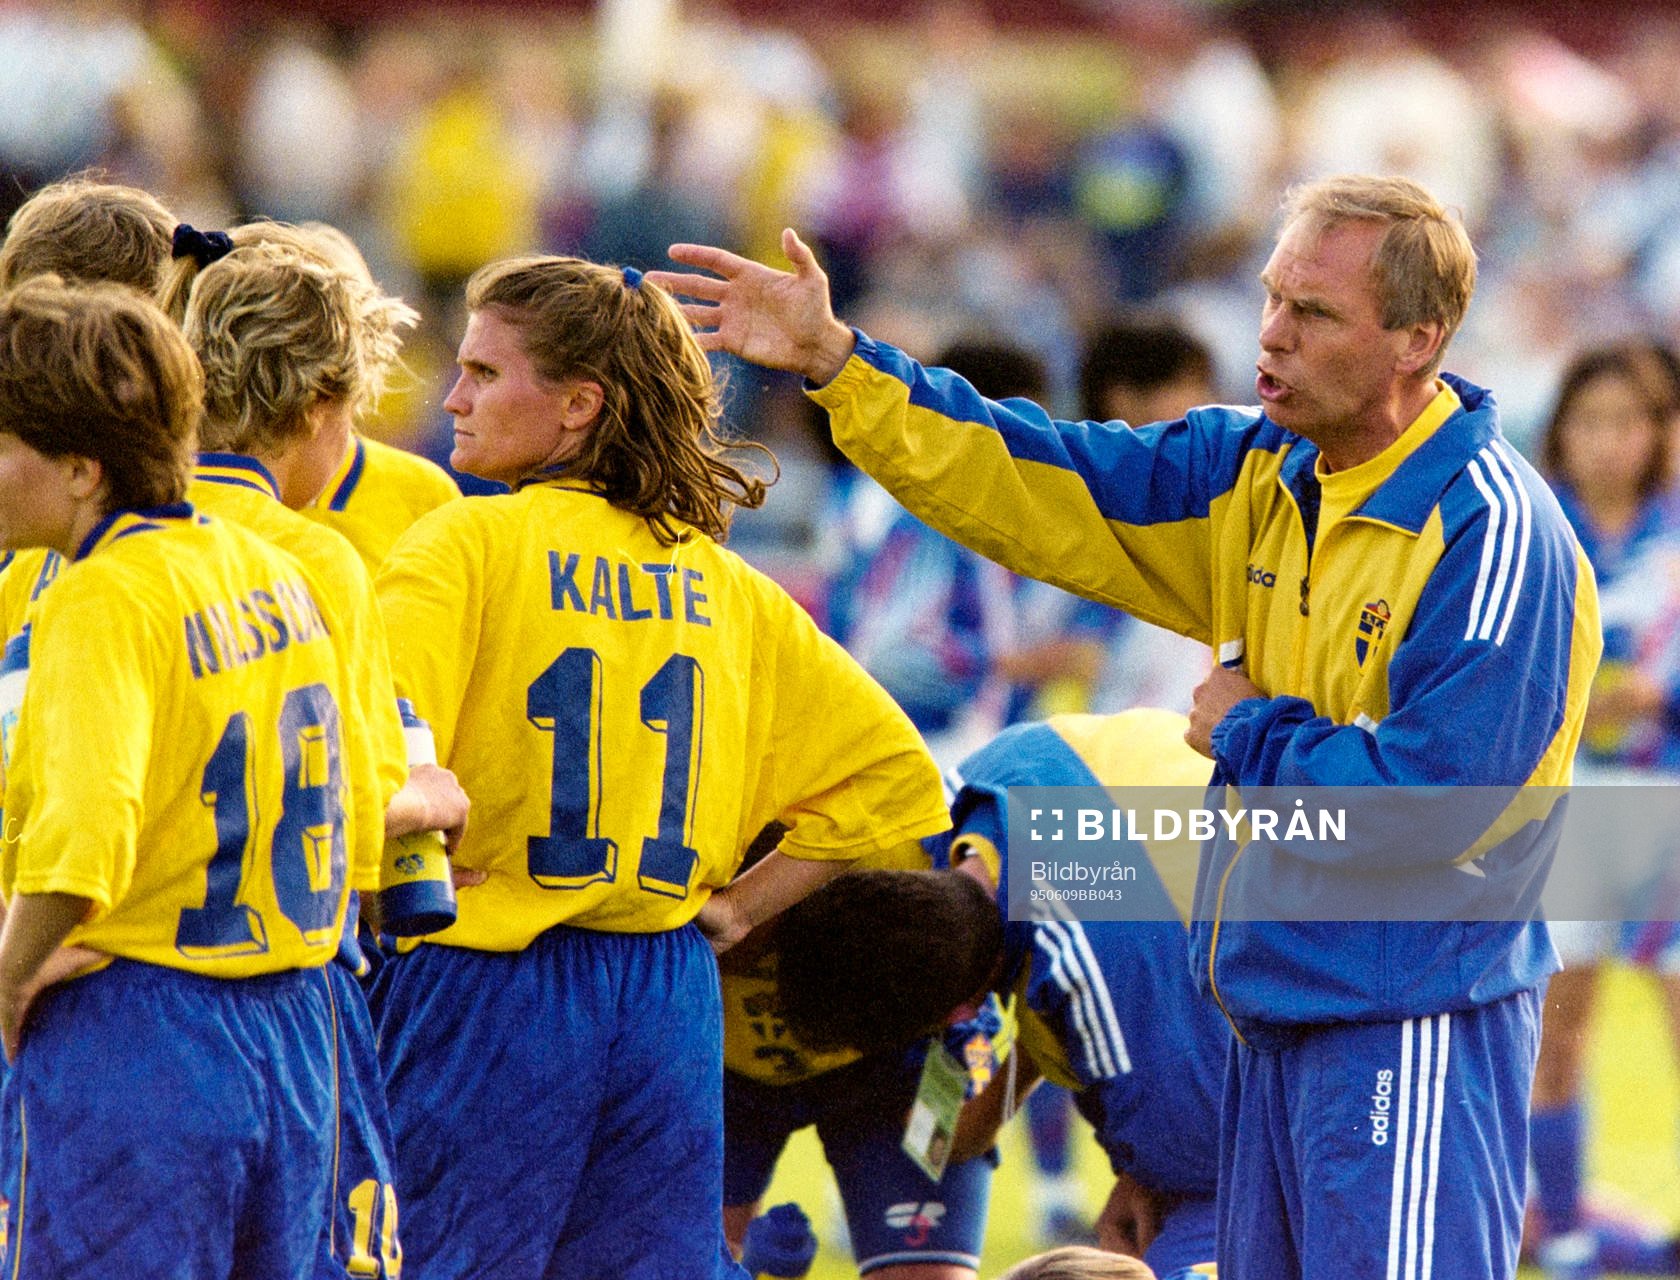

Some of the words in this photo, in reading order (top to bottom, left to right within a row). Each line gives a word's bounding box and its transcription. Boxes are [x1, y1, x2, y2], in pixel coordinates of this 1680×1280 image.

[547, 550, 712, 627] KALTE
[174, 682, 350, 960] 18
[526, 646, 705, 901] 11
[1369, 1068, 1394, 1146] adidas
